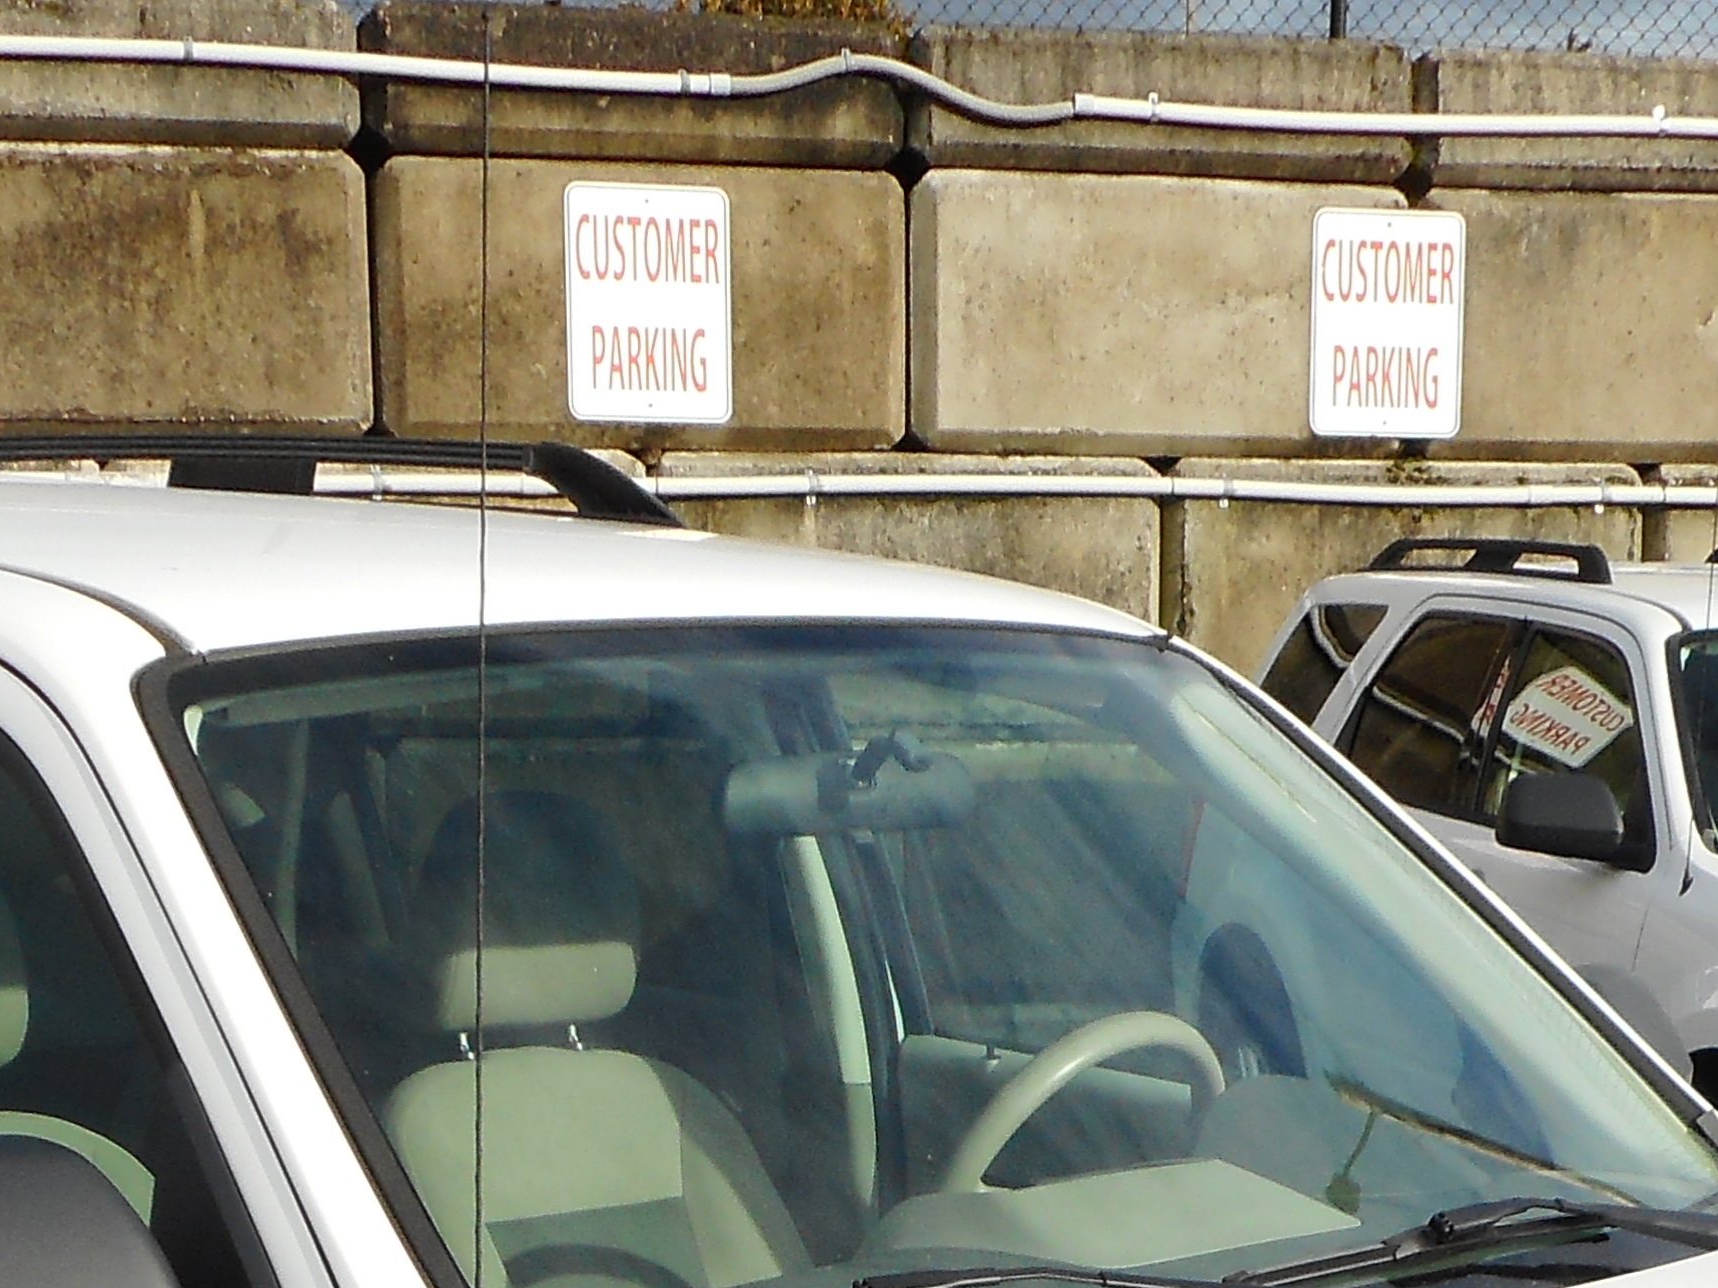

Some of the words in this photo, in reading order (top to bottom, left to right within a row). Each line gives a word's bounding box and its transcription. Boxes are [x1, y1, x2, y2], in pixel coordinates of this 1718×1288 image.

[575, 213, 720, 285] CUSTOMER
[1321, 238, 1455, 305] CUSTOMER
[591, 325, 708, 393] PARKING
[1332, 344, 1439, 410] PARKING
